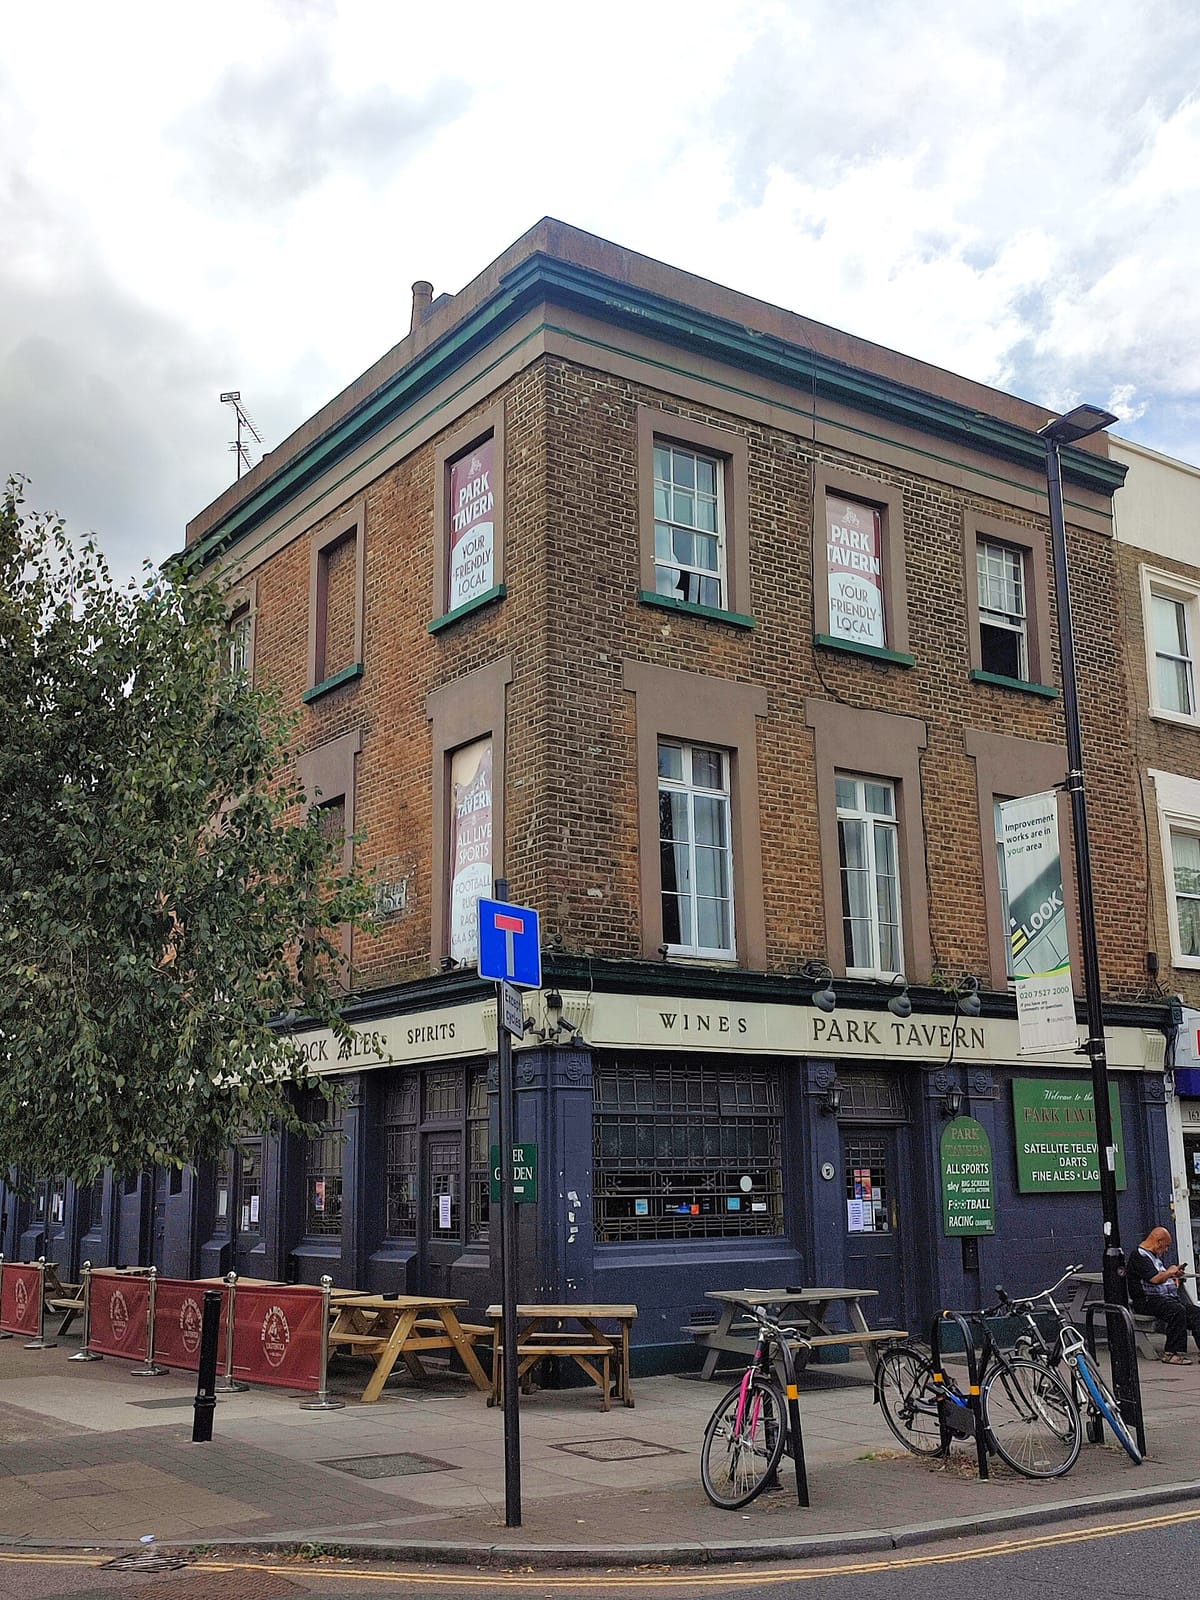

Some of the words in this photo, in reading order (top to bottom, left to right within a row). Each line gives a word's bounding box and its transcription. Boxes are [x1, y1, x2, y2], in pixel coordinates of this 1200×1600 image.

[460, 471, 490, 507] PARK
[453, 492, 494, 532] TAVERN
[462, 535, 485, 560] YOUR
[831, 524, 870, 552] PARK
[455, 550, 491, 582] FRIENDLY
[827, 543, 880, 575] TAVERN
[458, 575, 487, 597] LOCAL
[838, 582, 868, 604] YOUR
[831, 597, 877, 621] FRIENDLY
[836, 616, 874, 636] LOCAL
[1005, 813, 1054, 832] Improvement
[458, 830, 471, 848] ALL
[1006, 832, 1029, 843] works
[1031, 830, 1043, 838] are
[1044, 827, 1051, 835] in
[459, 842, 489, 866] SPORTS
[1007, 847, 1025, 857] your
[1026, 842, 1042, 852] area
[455, 874, 491, 896] FOOTBALL
[463, 894, 478, 909] RUG
[1021, 890, 1064, 939] LOOK
[505, 989, 521, 1013] Except
[1020, 991, 1032, 999] 020
[1034, 989, 1051, 998] 7527
[1053, 986, 1069, 995] 2000
[506, 1010, 521, 1029] cycles
[659, 1012, 748, 1033] WINES
[407, 1022, 456, 1045] SPIRITS
[812, 1018, 881, 1045] PARK
[891, 1022, 985, 1049] TAVERN
[1044, 1089, 1072, 1101] Welcome
[1074, 1093, 1081, 1101] to
[1083, 1092, 1094, 1101] the
[1023, 1106, 1060, 1123] PARK
[951, 1127, 980, 1140] PARK
[512, 1149, 524, 1162] ER
[1024, 1143, 1069, 1154] SATELLITE
[946, 1164, 960, 1175] ALL
[961, 1163, 989, 1175] SPORTS
[1059, 1157, 1088, 1167] DARTS
[494, 1166, 533, 1181] GDEN
[1032, 1171, 1052, 1181] FINE
[1053, 1170, 1076, 1181] ALES
[947, 1181, 960, 1193] sky
[948, 1199, 990, 1210] FOOTBALL
[949, 1216, 974, 1227] RACING
